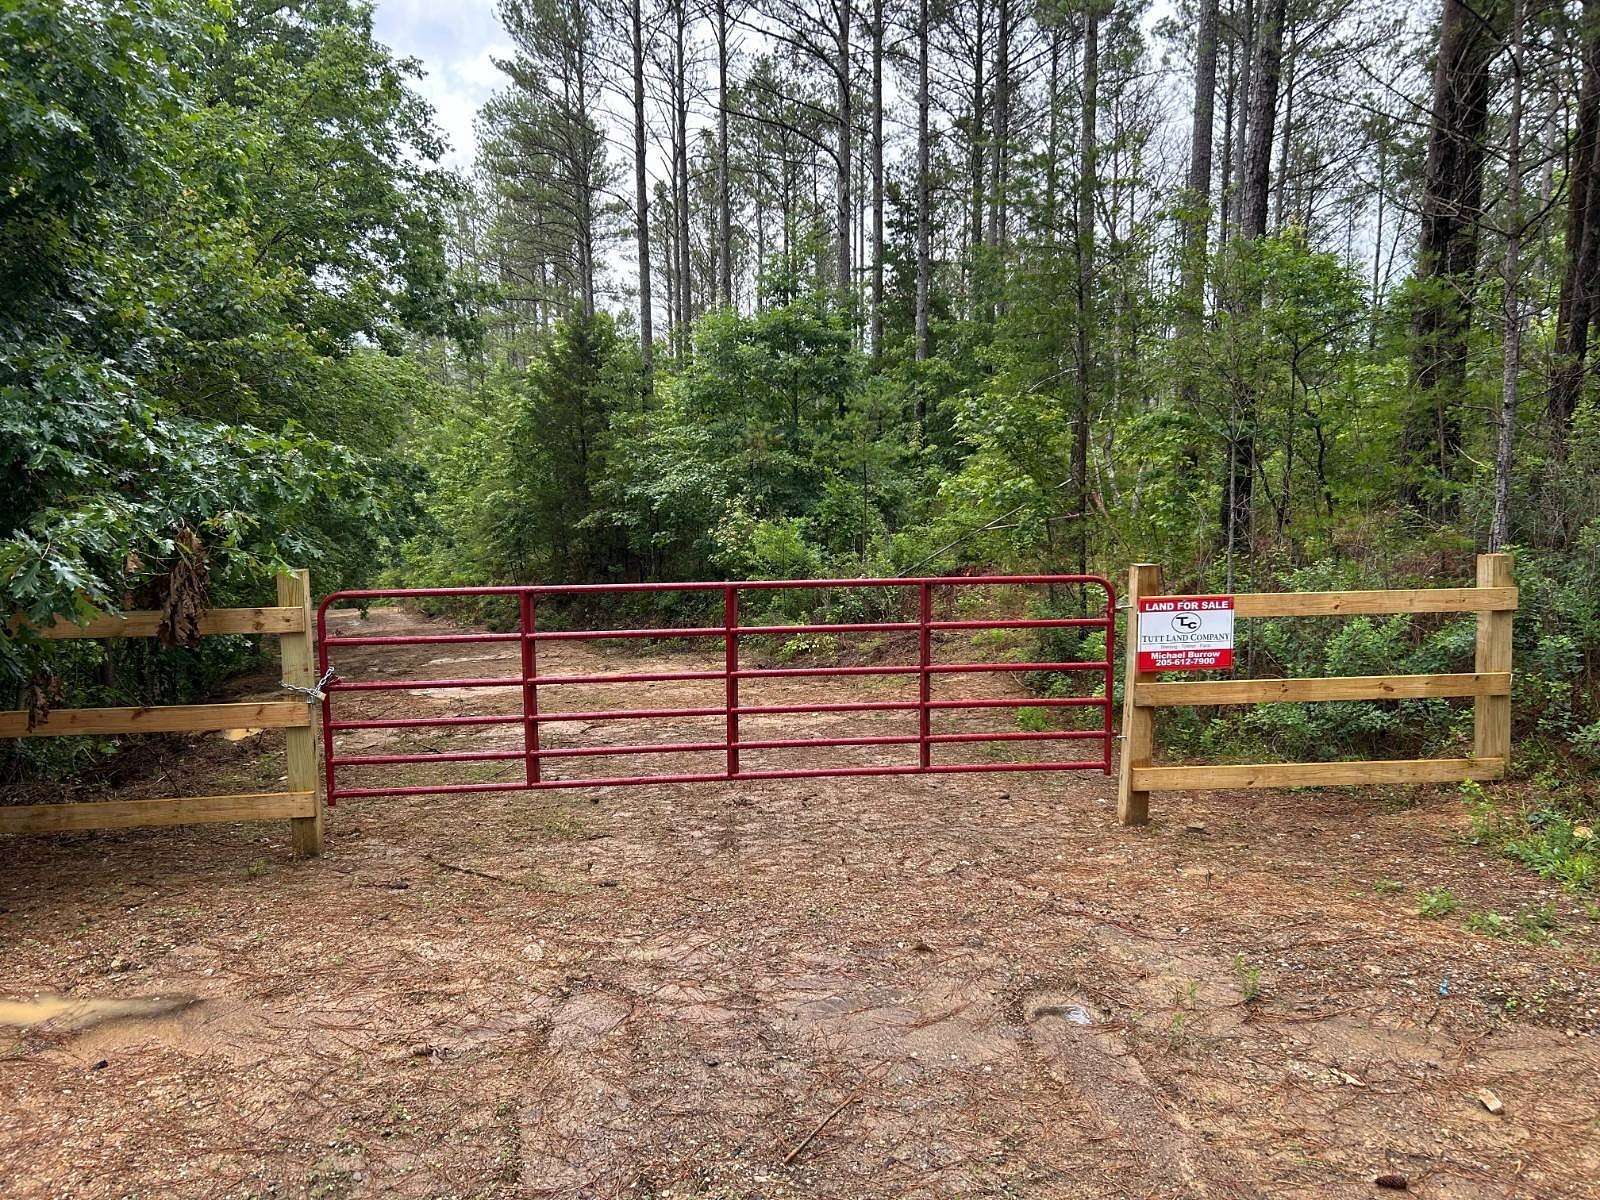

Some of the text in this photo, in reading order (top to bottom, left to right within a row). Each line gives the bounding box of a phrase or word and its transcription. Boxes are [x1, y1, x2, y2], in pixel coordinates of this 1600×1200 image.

[1145, 600, 1229, 611] LAND FOR SALE
[1143, 633, 1230, 643] TUTT LAND COMPANY
[1151, 651, 1185, 659] Michael
[1155, 658, 1215, 666] 205-612-7900
